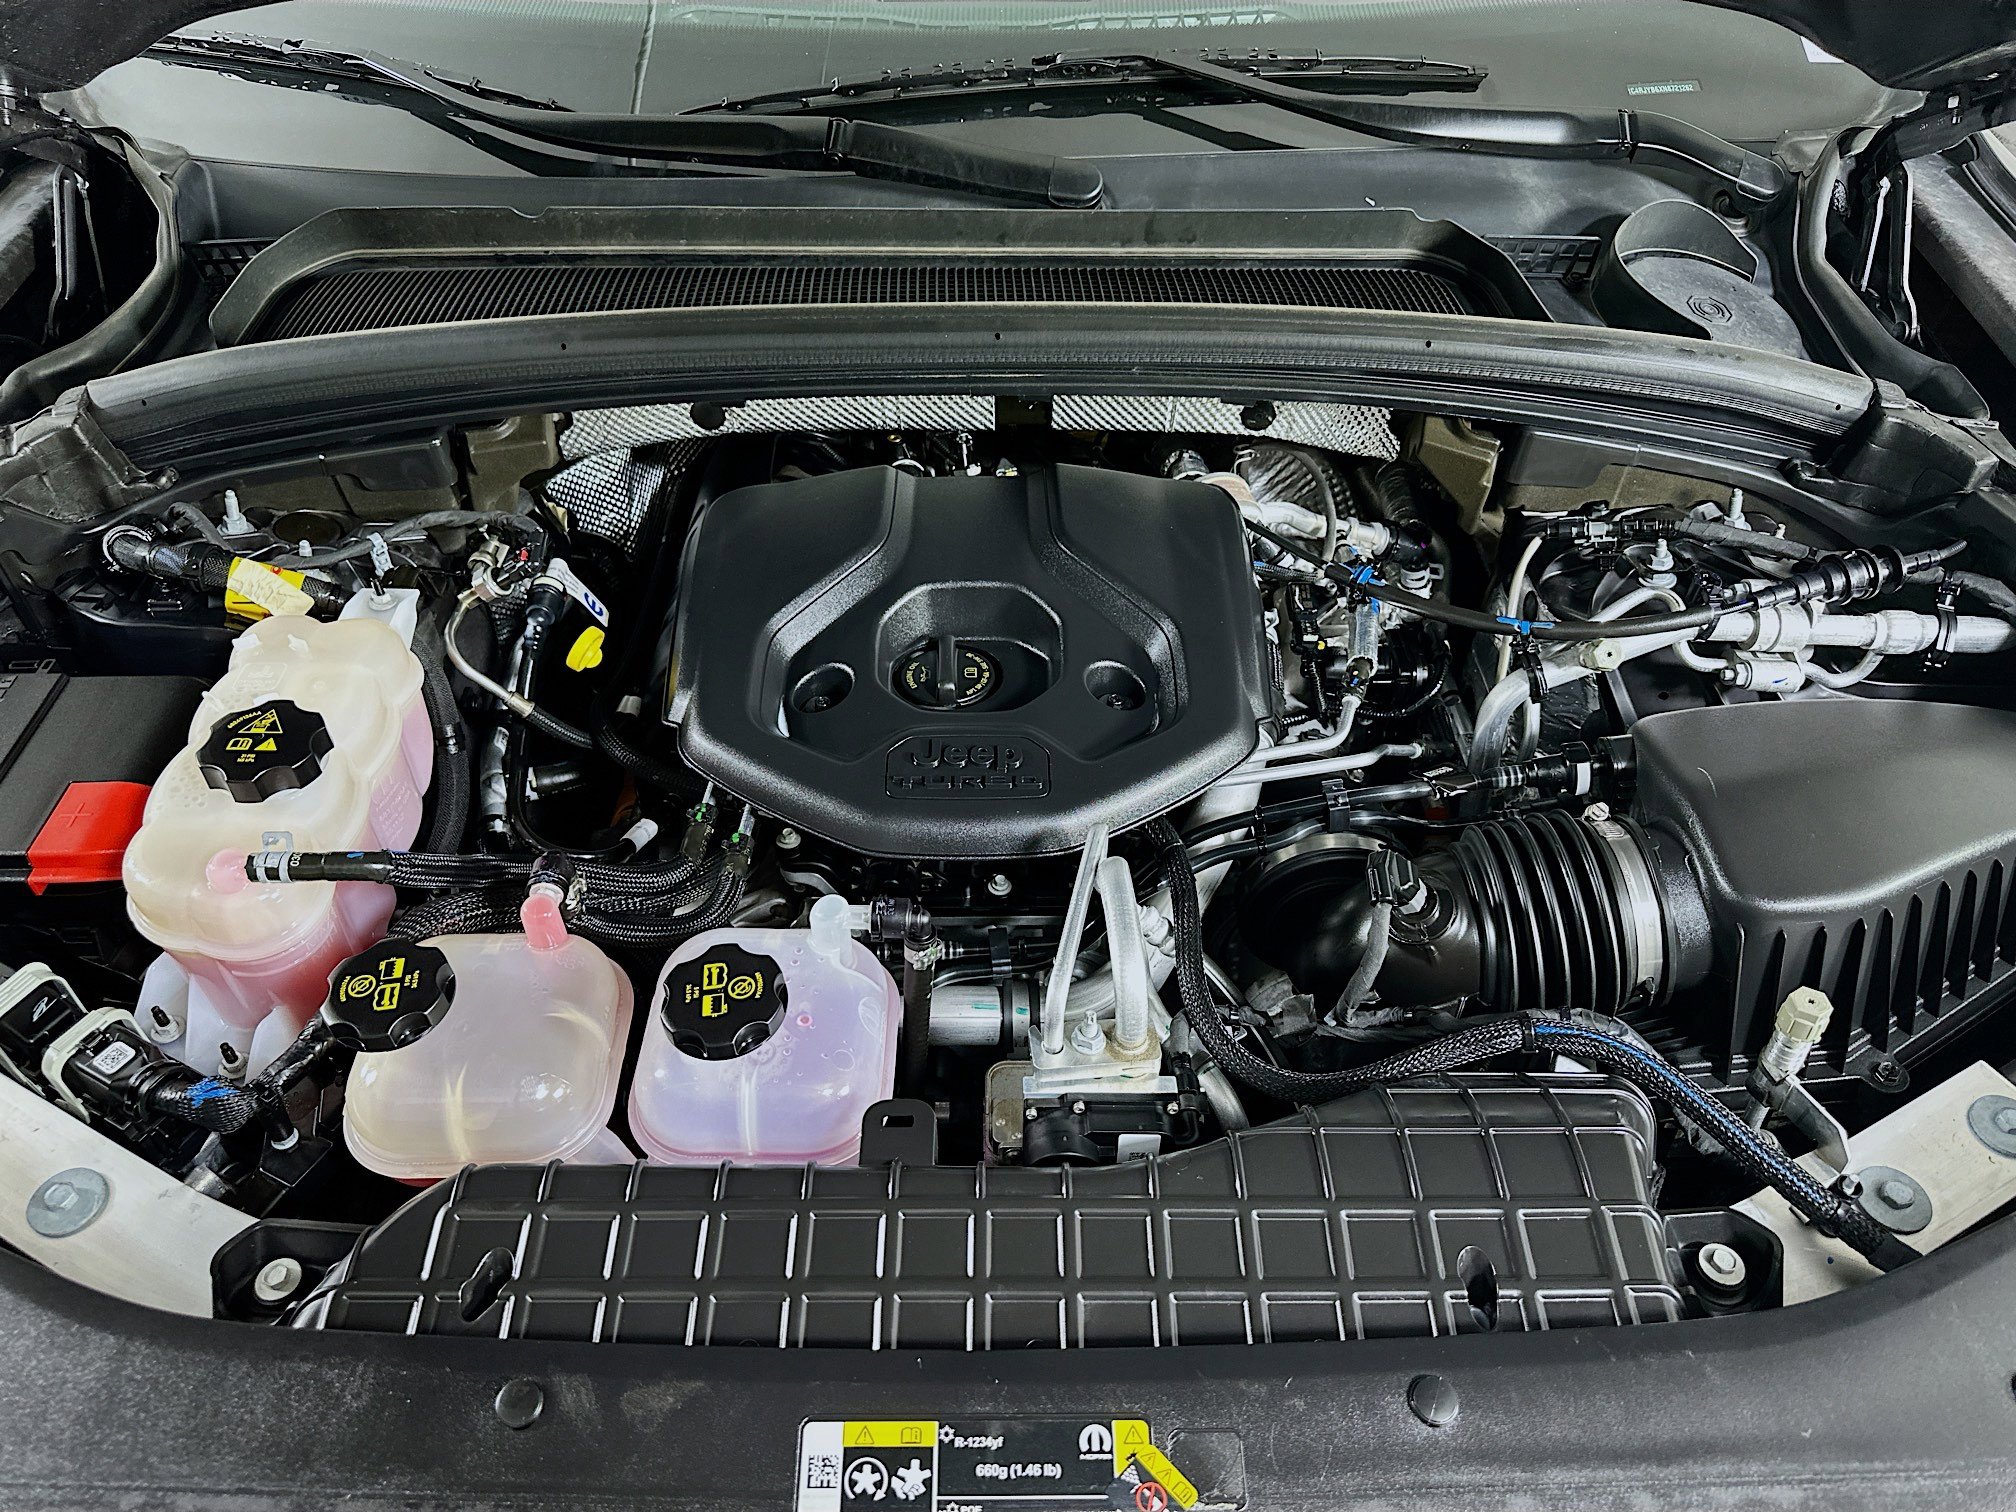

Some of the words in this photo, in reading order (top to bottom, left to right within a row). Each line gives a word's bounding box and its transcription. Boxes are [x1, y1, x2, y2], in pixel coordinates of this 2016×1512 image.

[911, 739, 1024, 773] Jeep
[890, 775, 1042, 789] TURBO
[954, 1436, 1004, 1450] R-1234yf
[975, 1464, 1008, 1479] 660g
[1010, 1463, 1042, 1479] (1.46
